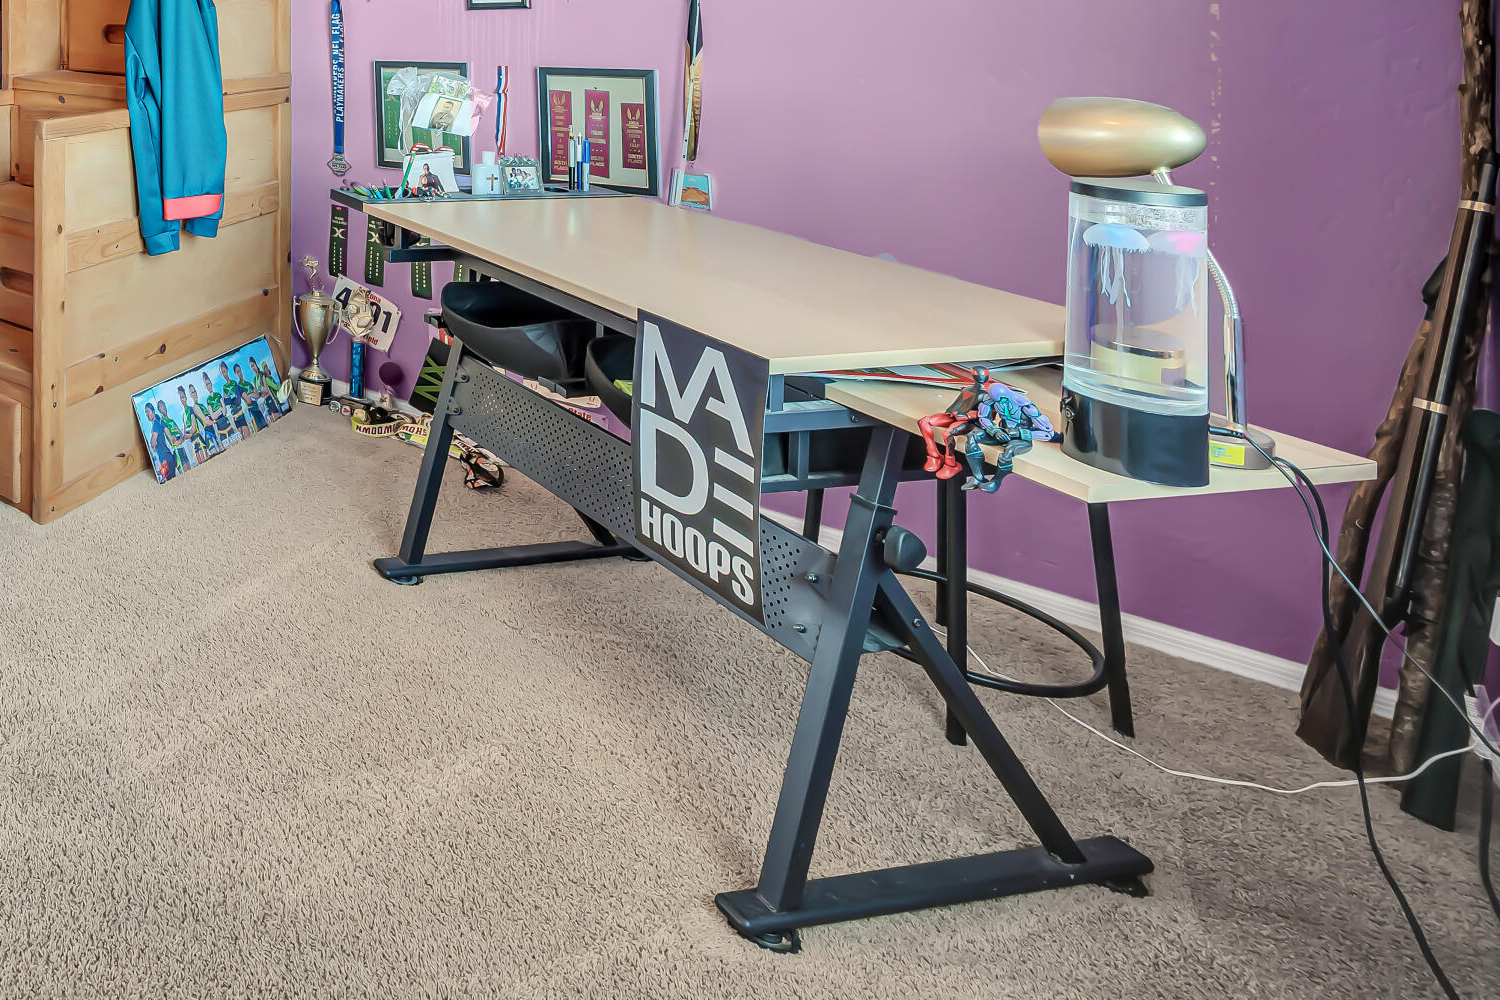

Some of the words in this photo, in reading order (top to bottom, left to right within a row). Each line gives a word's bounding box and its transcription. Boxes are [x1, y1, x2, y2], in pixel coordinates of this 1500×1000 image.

[332, 13, 340, 35] FLAG
[335, 67, 344, 123] PLAYMAKERS
[335, 287, 392, 333] 401
[640, 498, 754, 606] HOOPS
